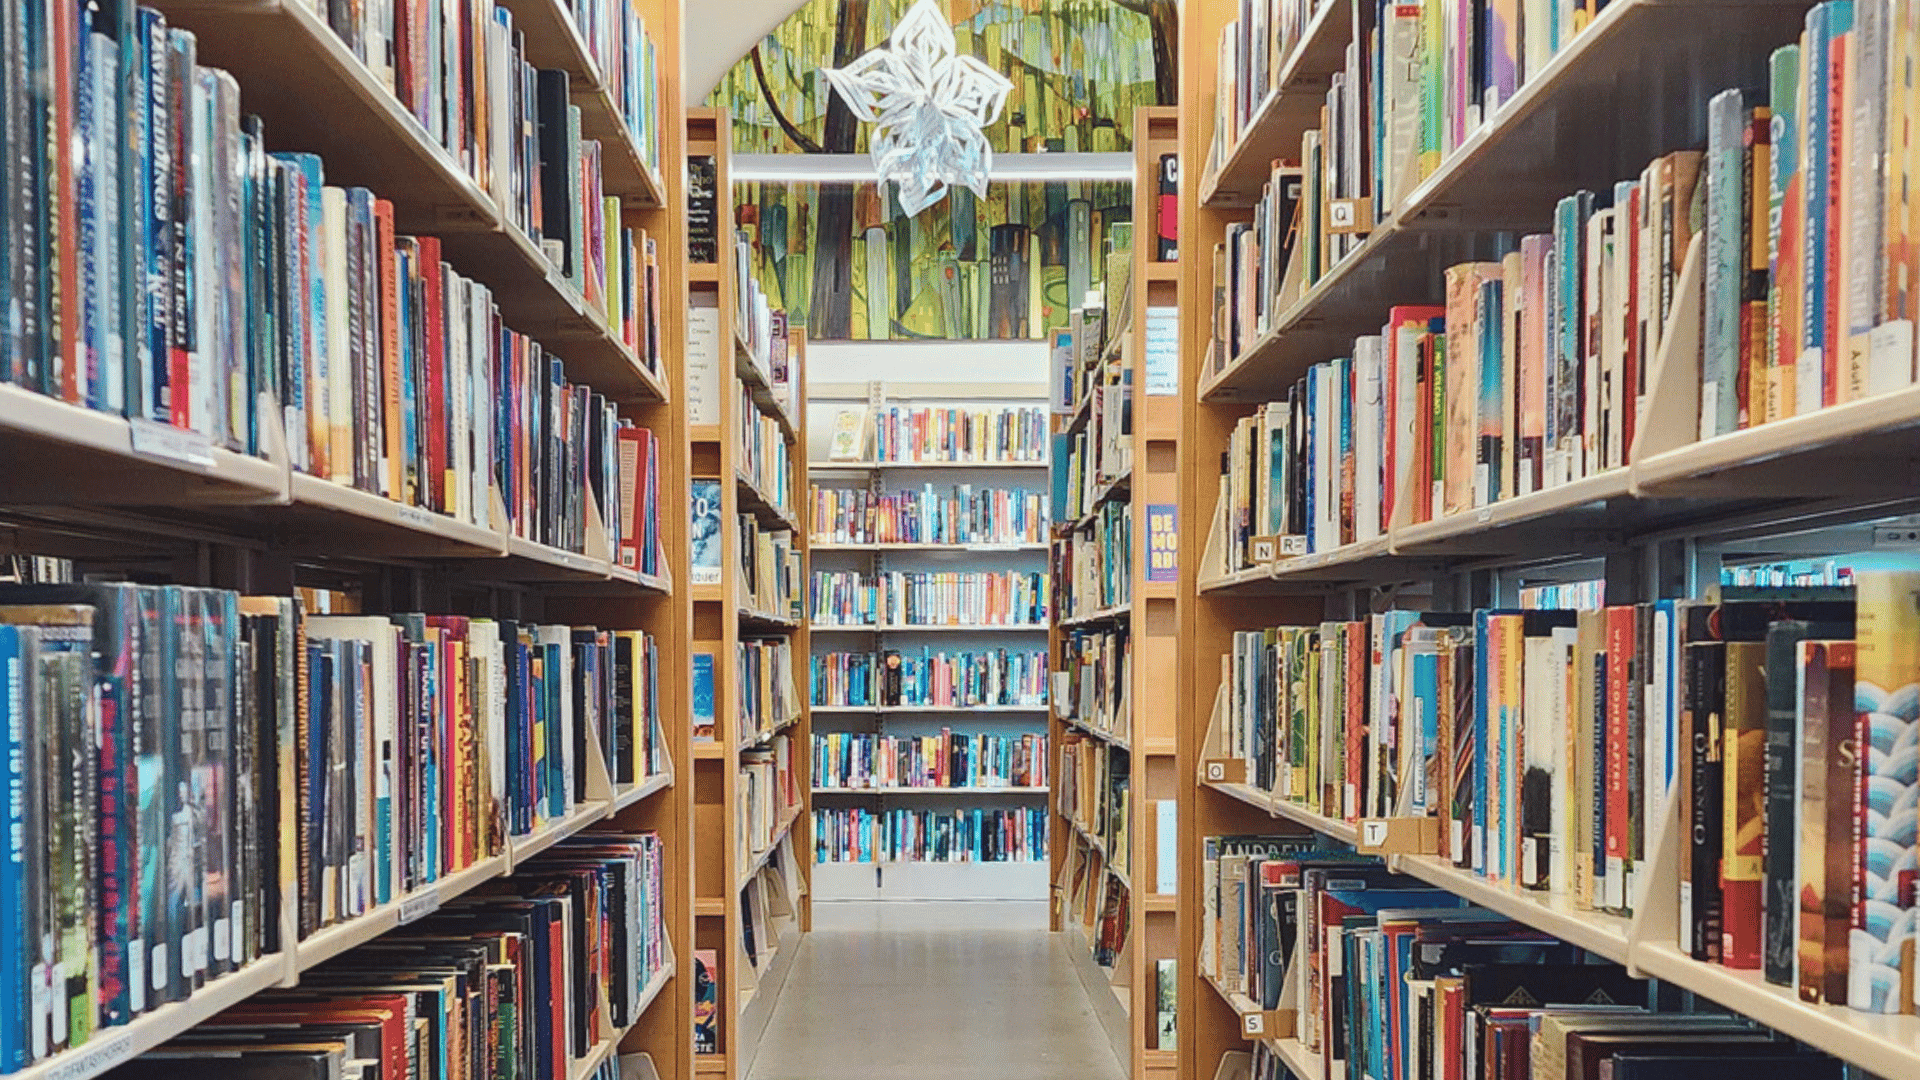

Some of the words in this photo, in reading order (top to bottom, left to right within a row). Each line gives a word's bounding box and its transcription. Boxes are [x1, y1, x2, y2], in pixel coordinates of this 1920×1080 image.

[1769, 114, 1786, 199] Good
[1769, 203, 1784, 262] Dirt
[1851, 349, 1862, 391] Adult
[1768, 380, 1777, 417] Adult
[1151, 514, 1173, 532] BE
[1260, 546, 1269, 558] N
[1612, 628, 1621, 674] WHAT
[1612, 678, 1621, 735] COMES
[1612, 740, 1621, 791] AFTER
[1693, 732, 1706, 846] ORLANDO
[1853, 721, 1863, 813] EVERYTHING
[72, 747, 85, 881] American
[1368, 825, 1378, 842] T
[1249, 1017, 1259, 1031] S
